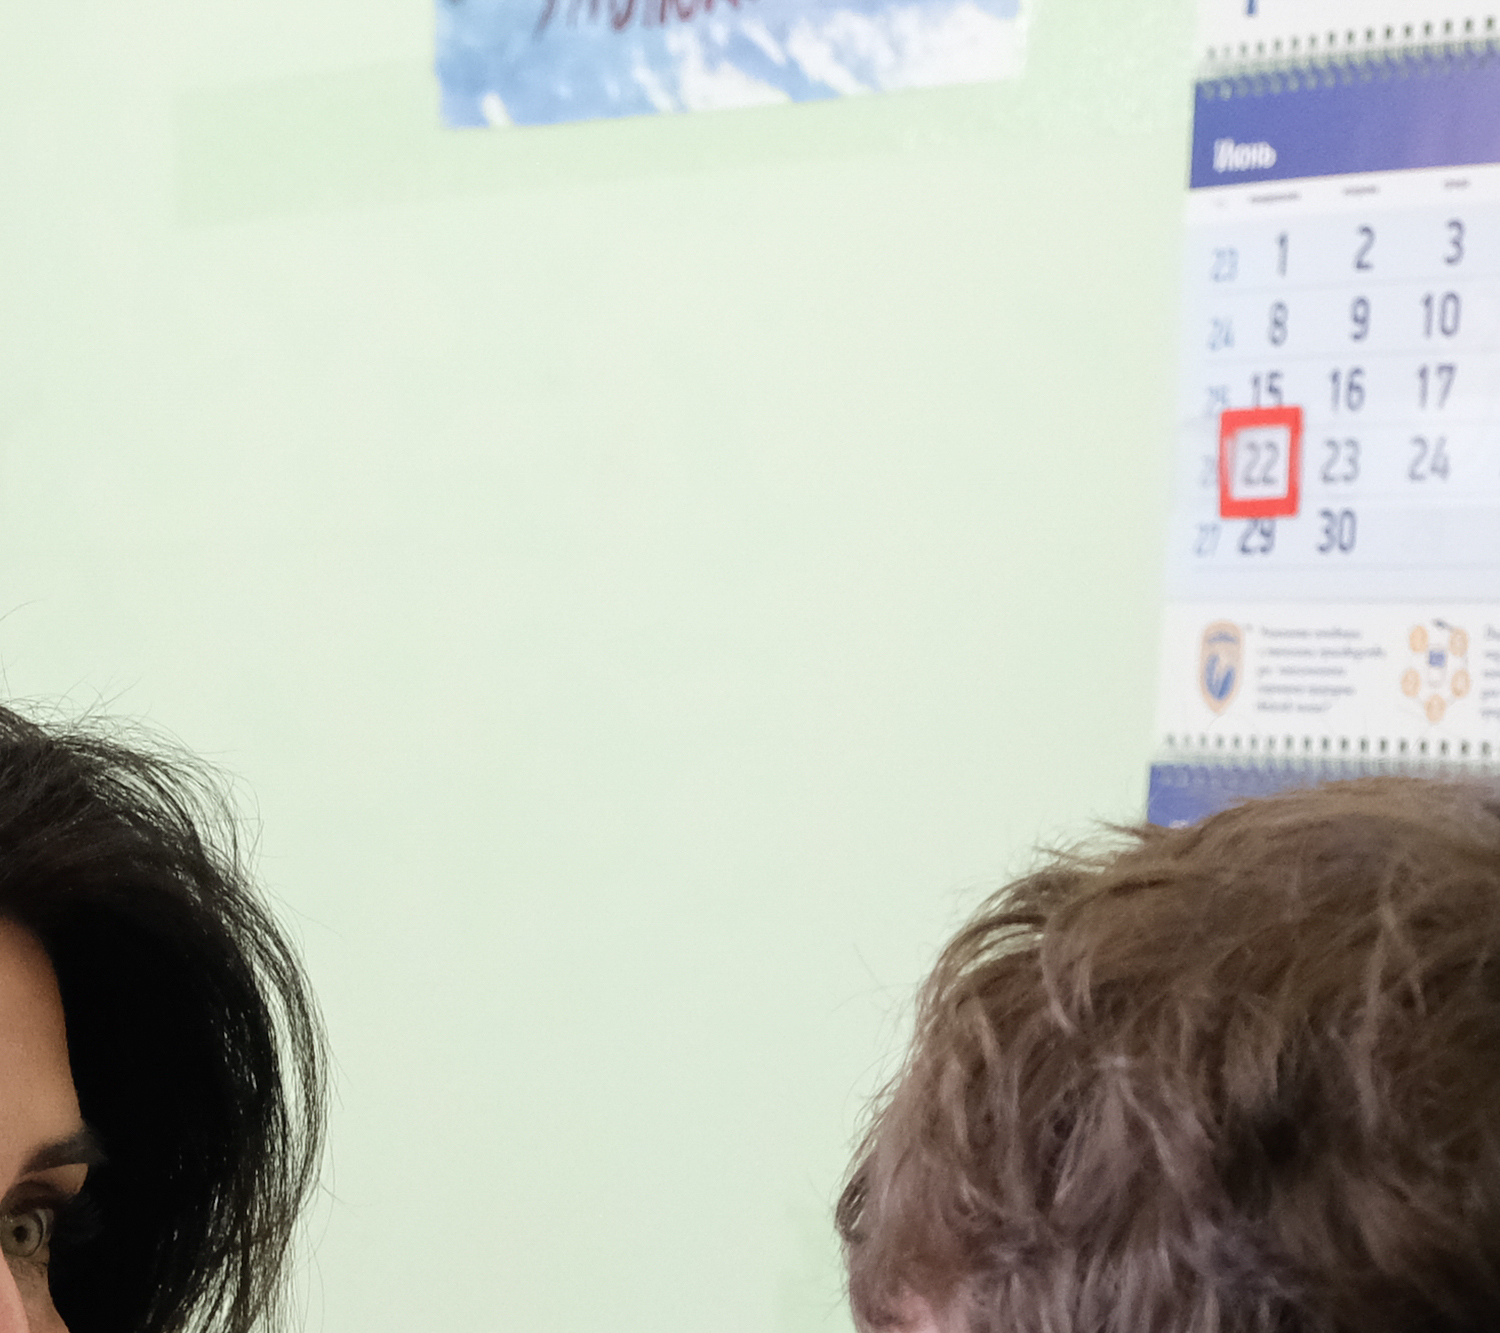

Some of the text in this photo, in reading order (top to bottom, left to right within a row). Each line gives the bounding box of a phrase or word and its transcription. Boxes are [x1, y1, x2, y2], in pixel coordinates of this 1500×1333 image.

[1213, 138, 1277, 172] Июнь
[1275, 229, 1290, 277] 1
[1352, 222, 1377, 274] 2
[1442, 216, 1467, 268] 3
[1266, 299, 1290, 348] 8
[1348, 294, 1372, 344] 9
[1419, 289, 1463, 340] 10
[1250, 370, 1285, 409] 15
[1328, 365, 1367, 413] 16
[1415, 361, 1458, 409] 17
[1241, 440, 1280, 487] 22
[1319, 438, 1361, 486] 23
[1406, 434, 1451, 483] 24
[1238, 518, 1276, 557] 29
[1316, 509, 1359, 556] 30
